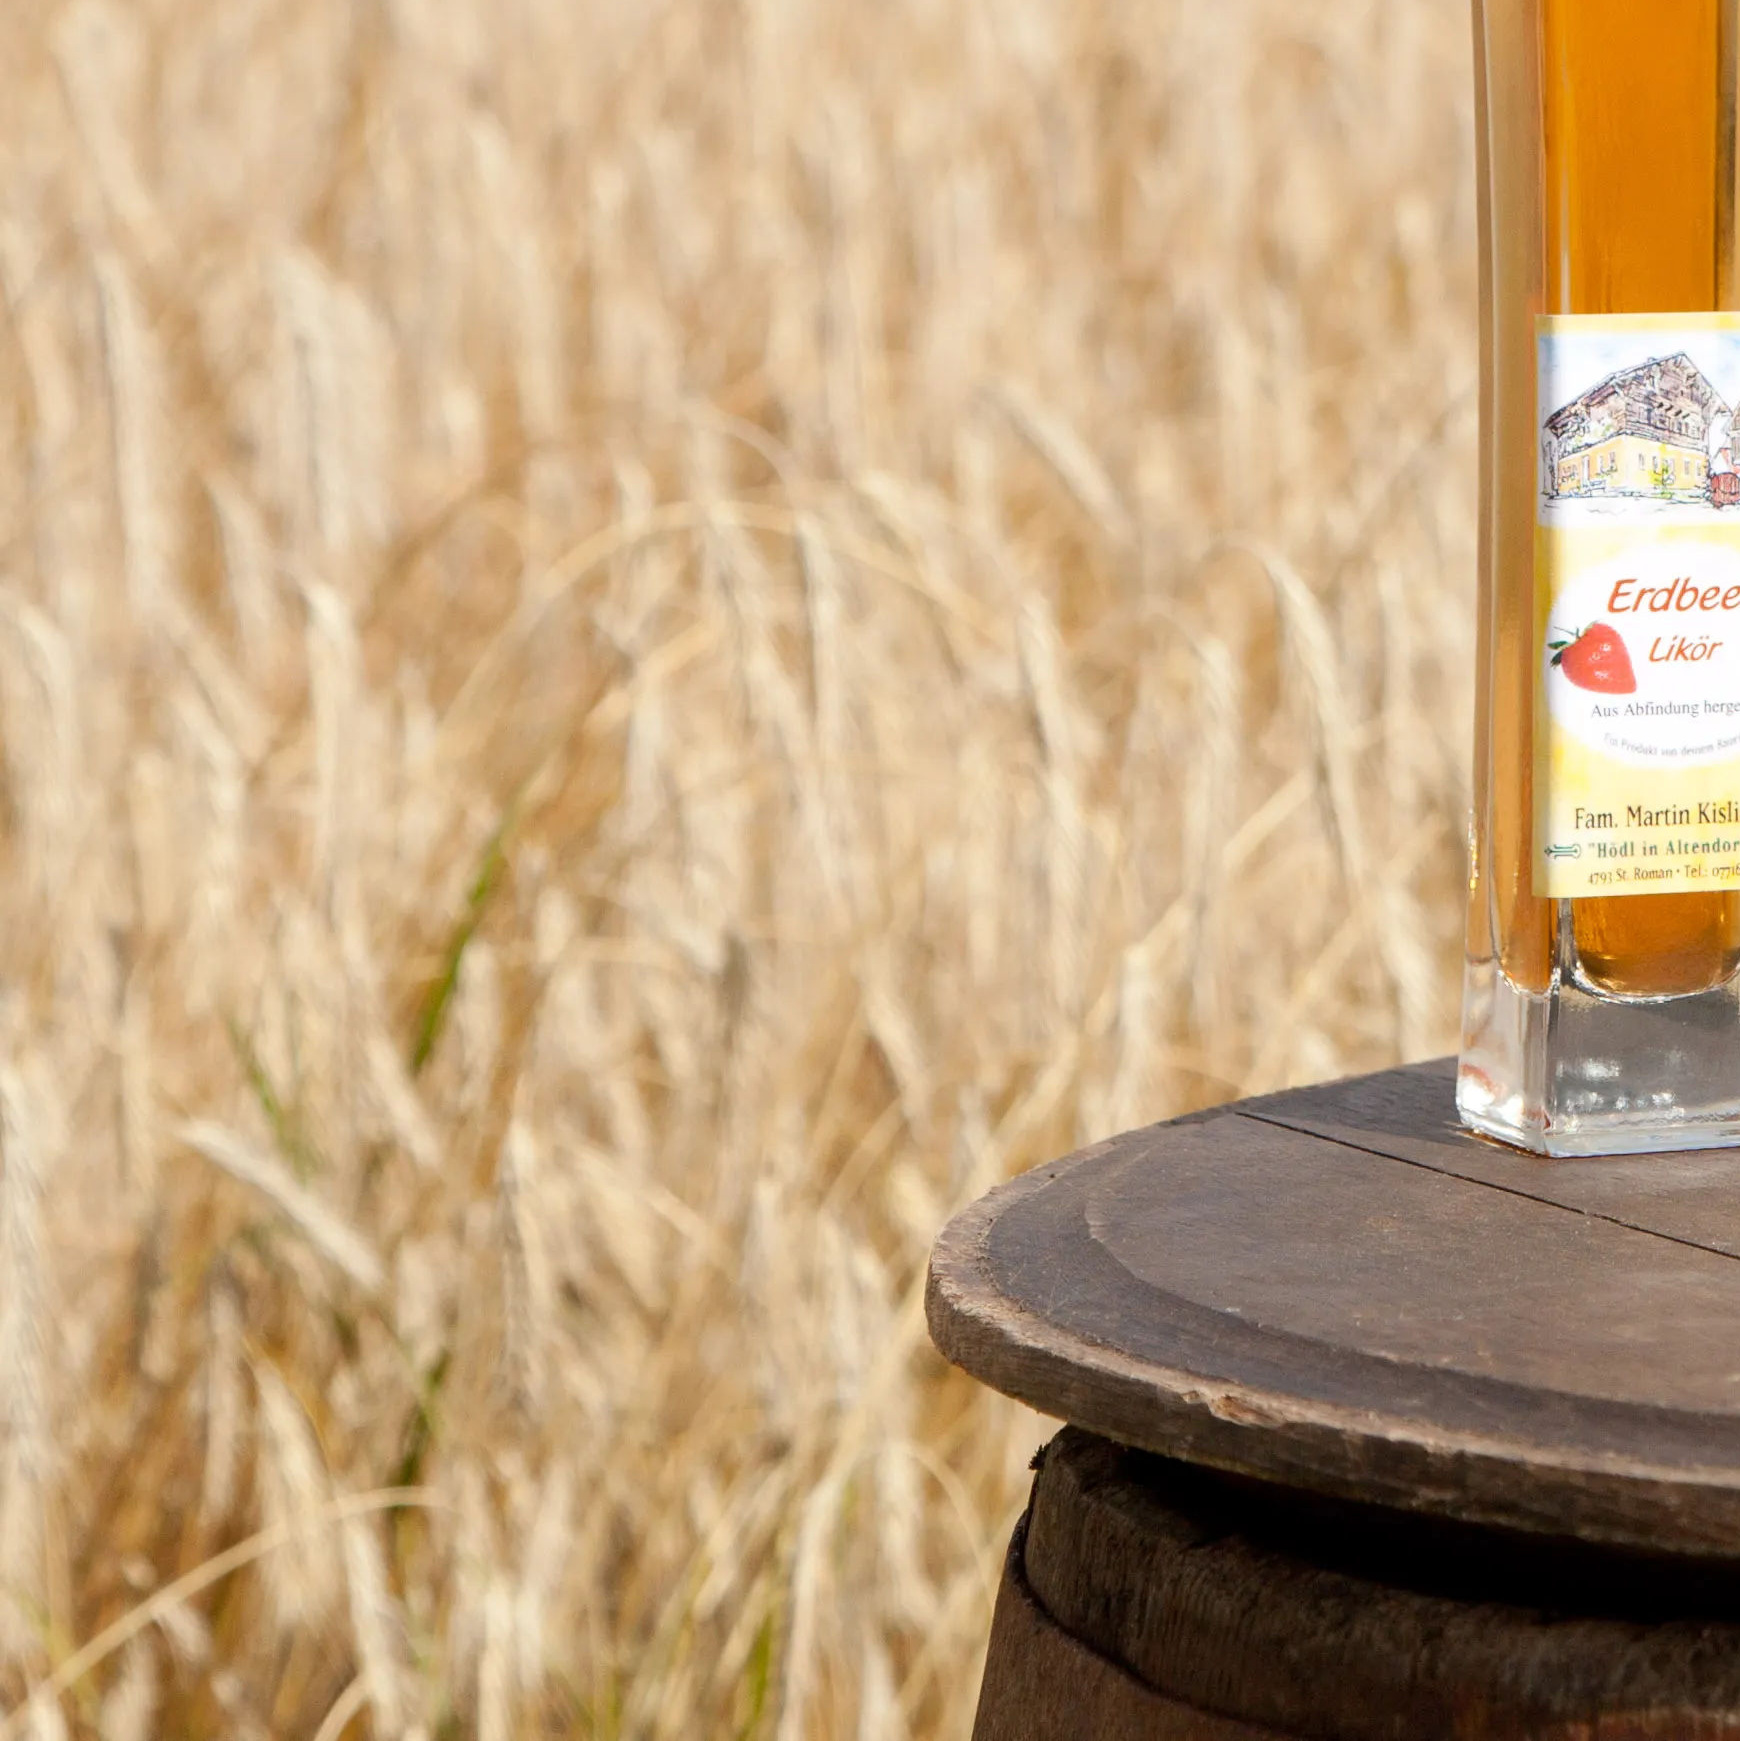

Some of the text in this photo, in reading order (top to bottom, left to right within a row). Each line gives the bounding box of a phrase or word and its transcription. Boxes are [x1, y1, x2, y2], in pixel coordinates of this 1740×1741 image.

[1649, 635, 1722, 663] Likör
[1591, 701, 1619, 717] Aus
[1624, 700, 1699, 718] Abfindung
[1575, 807, 1620, 830] Fam.
[1626, 804, 1691, 828] Martin
[1641, 841, 1659, 856] in
[1588, 868, 1613, 885] 4793
[1616, 867, 1630, 882] St.
[1634, 865, 1673, 881] Roman
[1685, 864, 1709, 879] Tel.:
